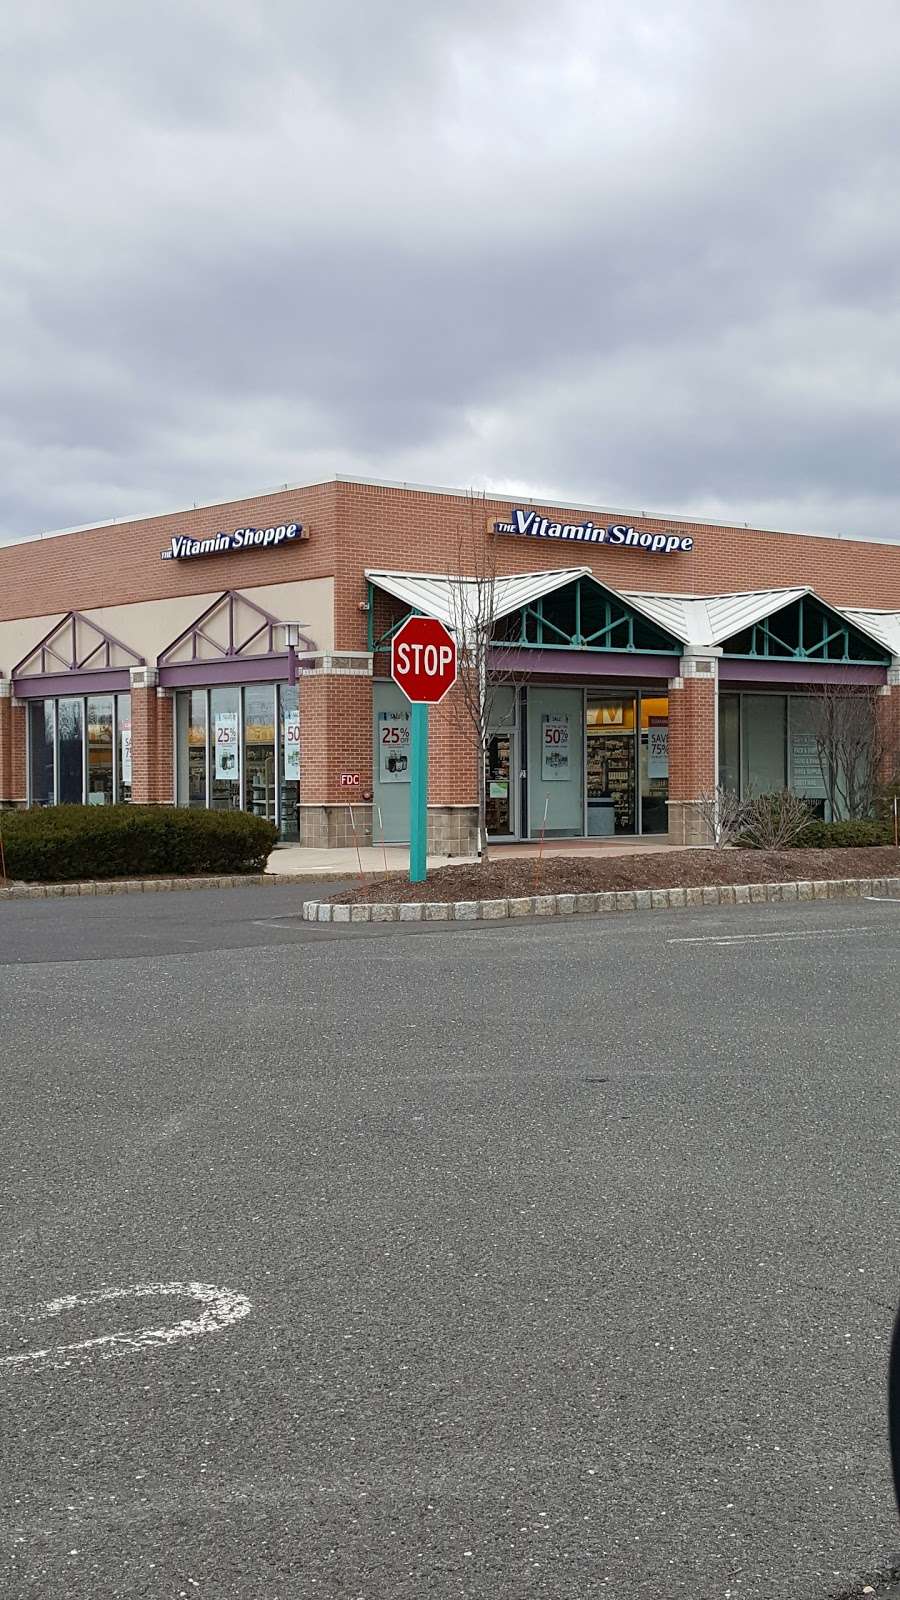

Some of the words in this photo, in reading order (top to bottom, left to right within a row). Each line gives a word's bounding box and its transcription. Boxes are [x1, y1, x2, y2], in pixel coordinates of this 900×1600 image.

[161, 550, 172, 560] THE
[170, 536, 230, 558] Vitamin
[232, 523, 297, 549] Shoppe
[498, 523, 516, 533] THE
[514, 509, 605, 542] Vitamin
[609, 524, 694, 553] Shoppe
[396, 642, 453, 677] STOP
[341, 774, 359, 785] FDC
